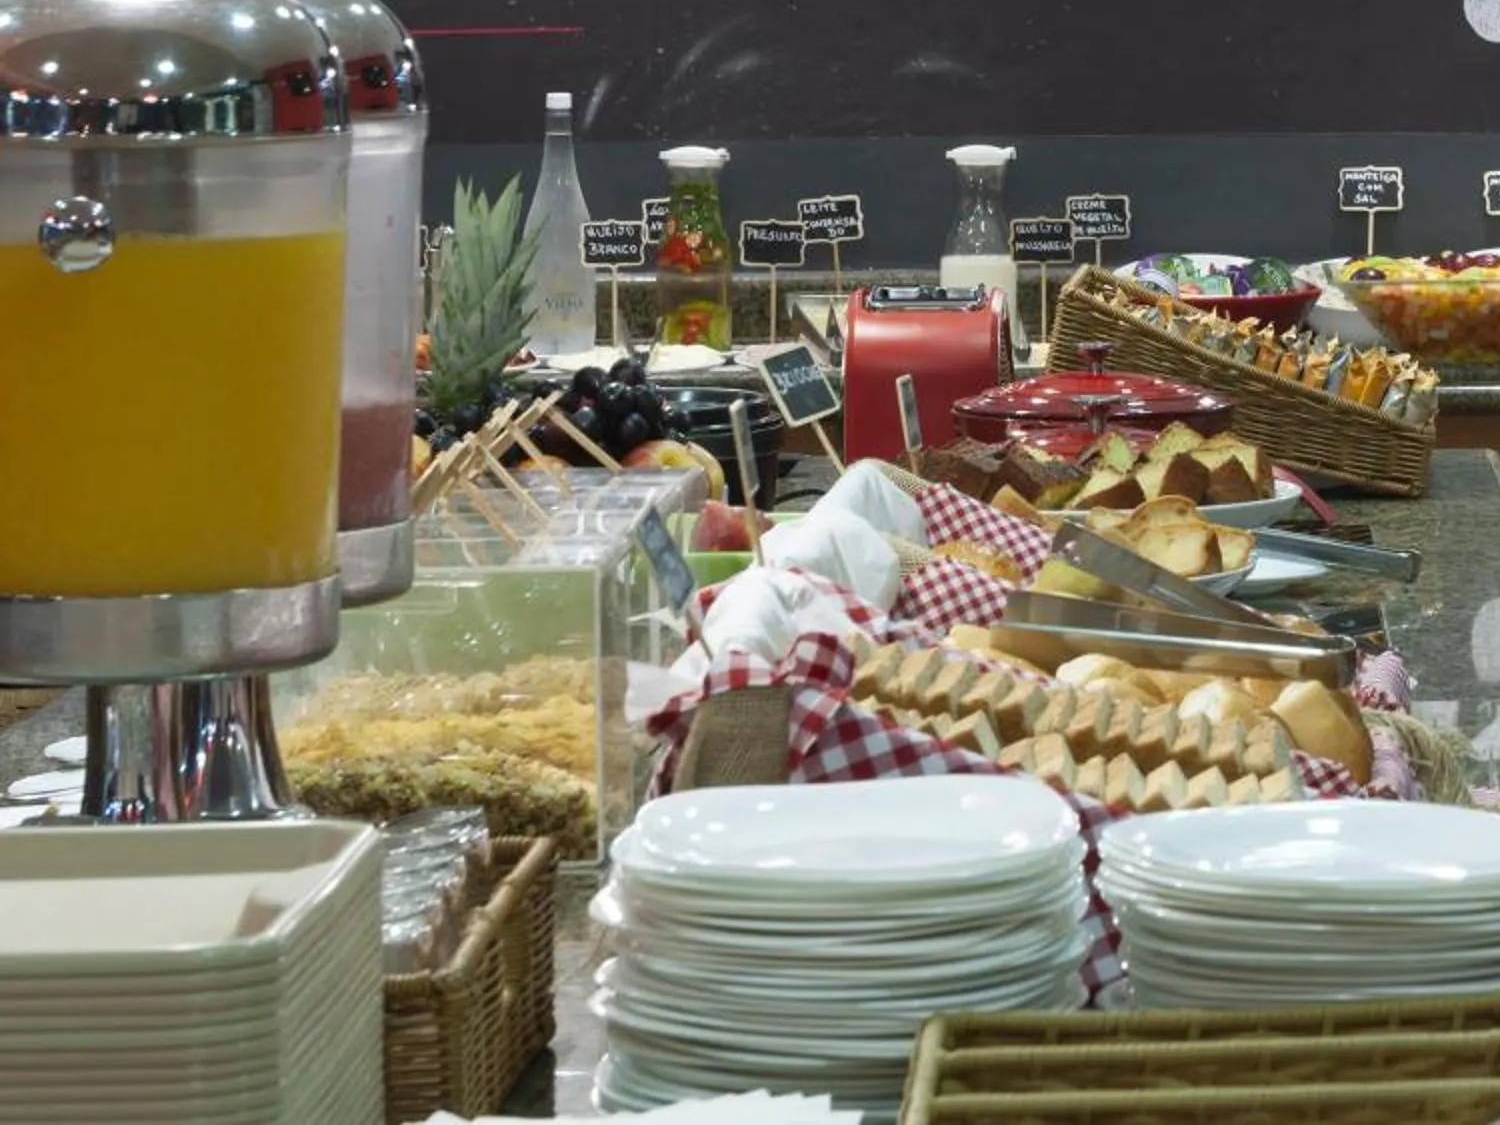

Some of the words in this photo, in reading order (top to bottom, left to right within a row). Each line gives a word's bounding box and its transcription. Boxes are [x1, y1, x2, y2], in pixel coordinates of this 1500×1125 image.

[1354, 194, 1378, 204] SAL
[803, 202, 838, 213] LEITE
[588, 242, 638, 255] BRANCO
